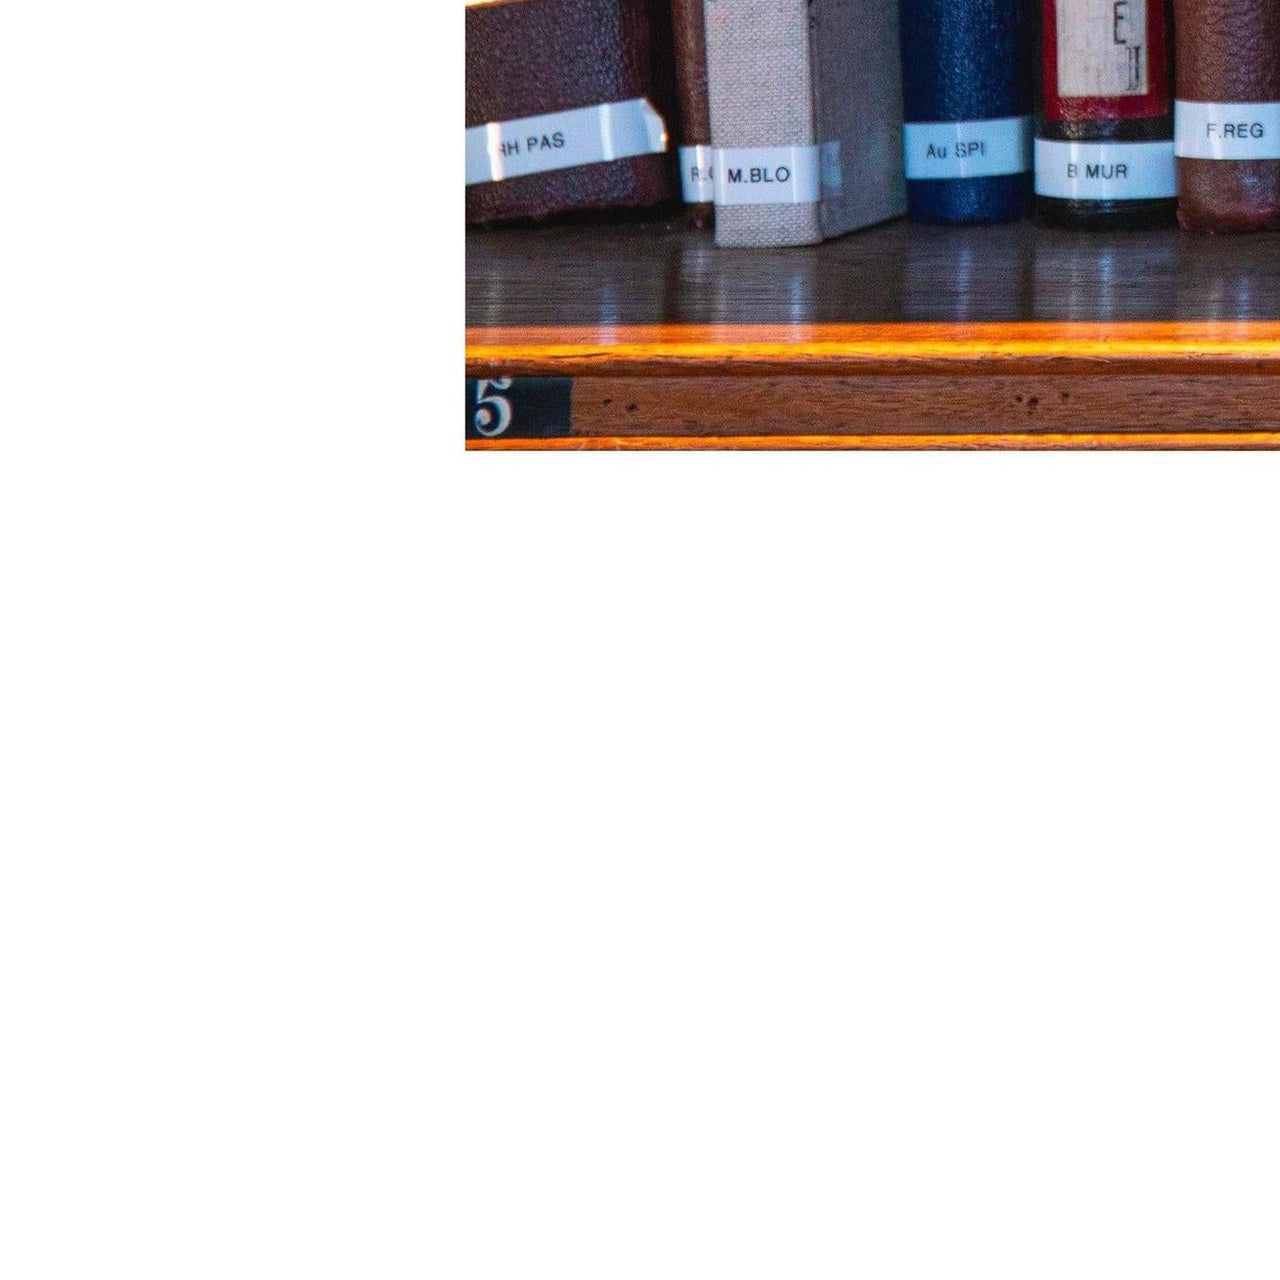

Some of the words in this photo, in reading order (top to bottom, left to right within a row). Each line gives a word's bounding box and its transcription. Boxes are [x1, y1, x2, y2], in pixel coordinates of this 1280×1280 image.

[1206, 122, 1265, 139] F.REG
[526, 131, 566, 153] PAS
[925, 143, 947, 160] Au
[954, 141, 987, 159] SPI
[726, 166, 791, 184] M.BLO
[1067, 163, 1078, 179] B
[1085, 163, 1128, 180] MUR
[475, 376, 512, 437] 5
